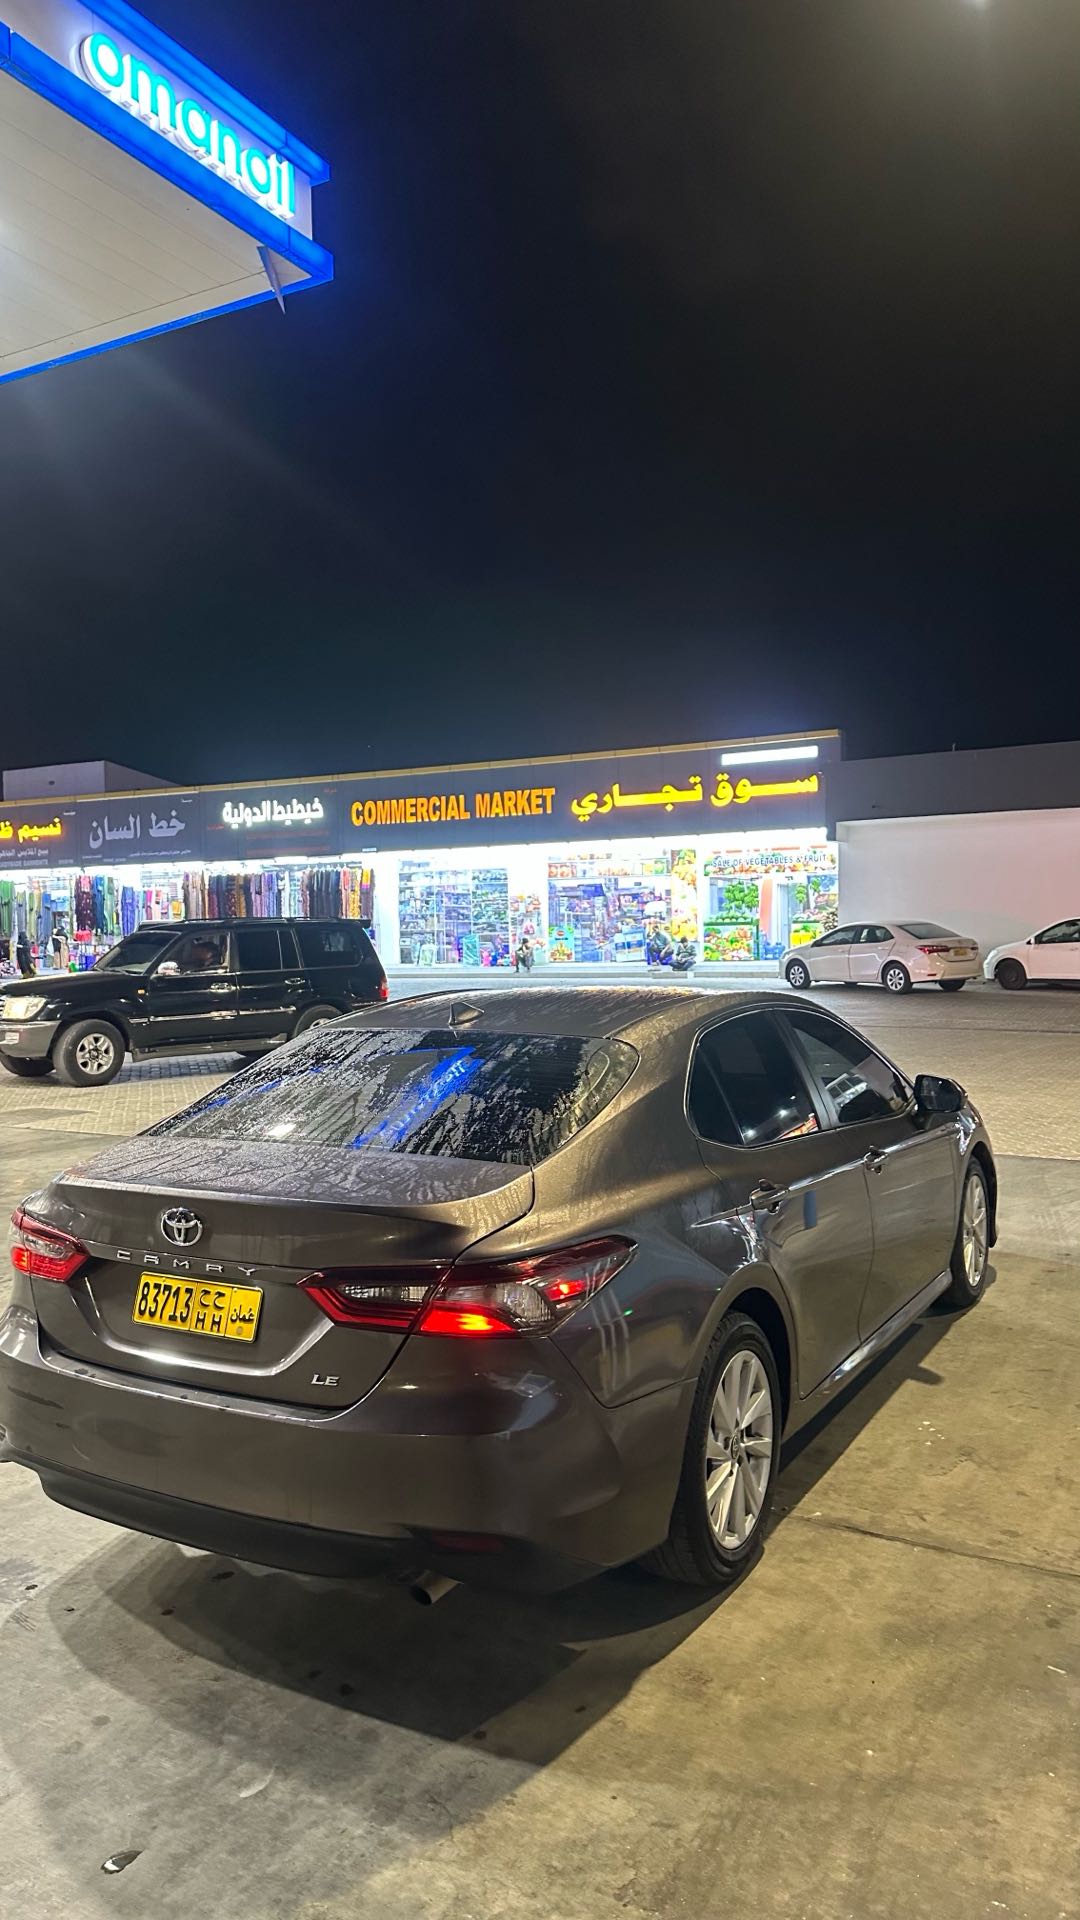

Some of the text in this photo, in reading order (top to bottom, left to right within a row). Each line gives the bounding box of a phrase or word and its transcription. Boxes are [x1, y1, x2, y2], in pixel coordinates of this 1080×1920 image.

[81, 32, 295, 218] omanoil
[222, 799, 272, 829] الدولية
[350, 787, 555, 827] COMMERCIAL MARKET
[571, 771, 819, 822] سوق تجاري
[17, 817, 62, 843] نسيم
[89, 809, 186, 849] خط السان
[745, 854, 794, 866] VEGETABLES
[116, 1249, 258, 1277] CAMRY
[138, 1281, 194, 1323] 83713
[311, 1373, 342, 1387] LE
